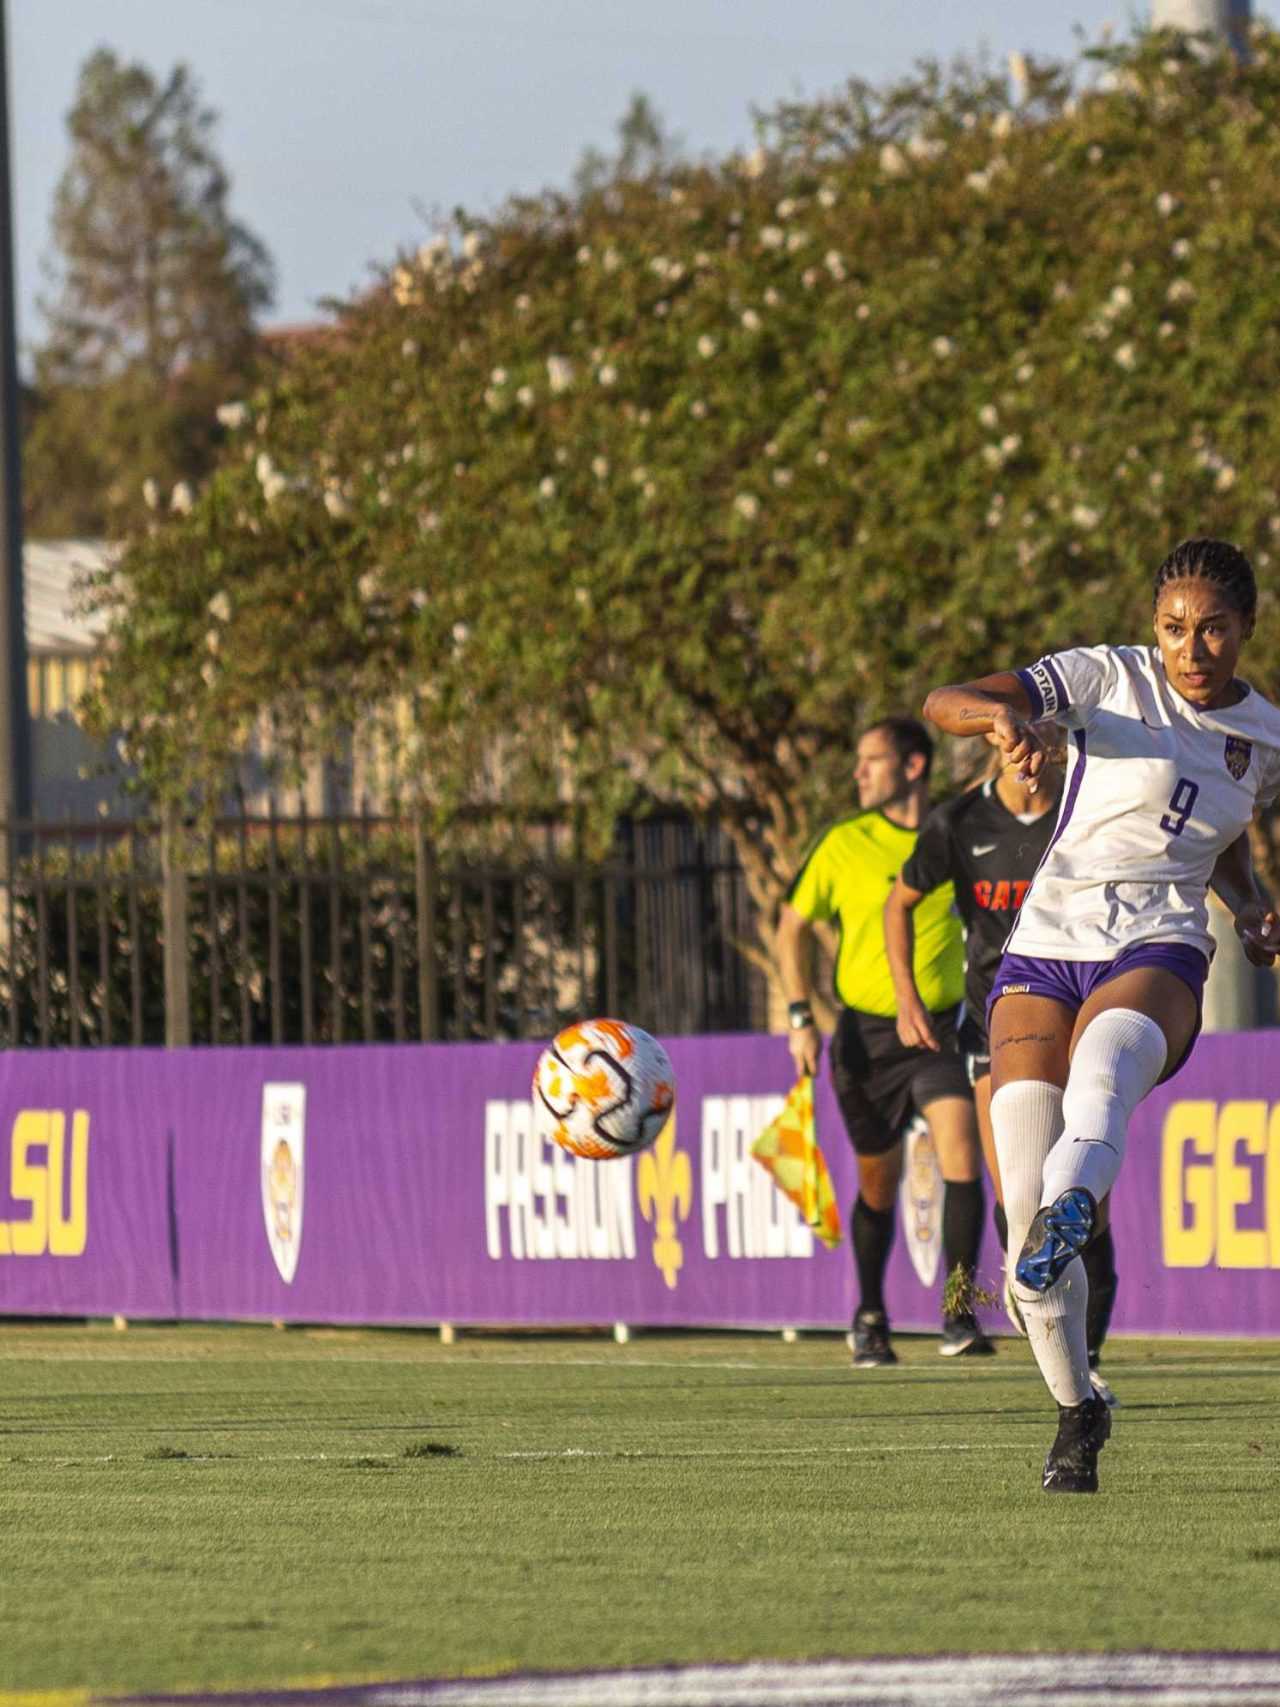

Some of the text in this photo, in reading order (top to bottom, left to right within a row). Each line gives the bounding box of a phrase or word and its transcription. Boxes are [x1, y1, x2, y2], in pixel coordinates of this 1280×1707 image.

[1031, 663, 1057, 712] APTAIN
[1160, 777, 1199, 836] 9
[974, 880, 1032, 911] GAT
[0, 1109, 90, 1257] SU
